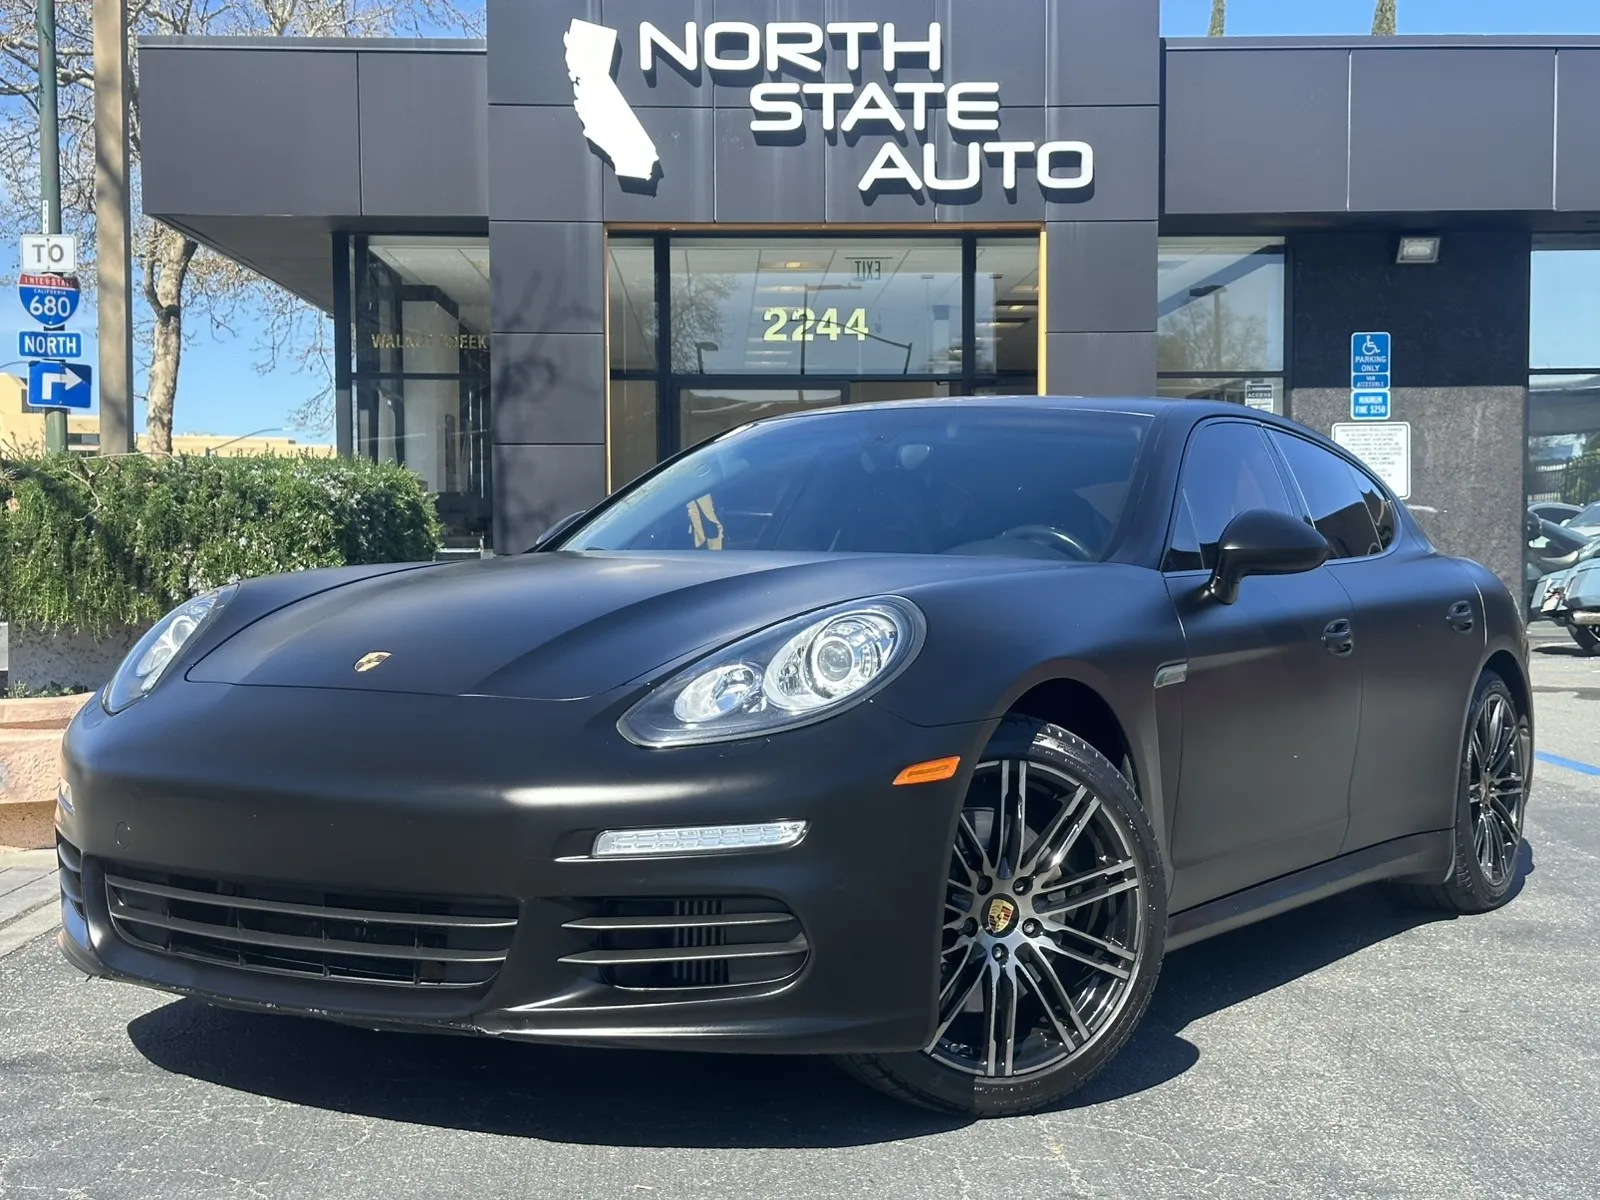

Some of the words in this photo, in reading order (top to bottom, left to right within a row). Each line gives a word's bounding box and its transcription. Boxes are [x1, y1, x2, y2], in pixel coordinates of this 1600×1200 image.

[639, 21, 941, 72] NORTH
[749, 81, 1000, 132] STATE
[857, 140, 1094, 191] AUTO
[32, 244, 64, 263] TO
[24, 275, 76, 288] INTERSTA
[29, 295, 71, 318] 680
[763, 307, 869, 341] 2244
[24, 335, 76, 356] NORTH
[440, 334, 488, 349] EEK
[1355, 355, 1387, 363] PARKING
[1361, 364, 1380, 372] ONLY
